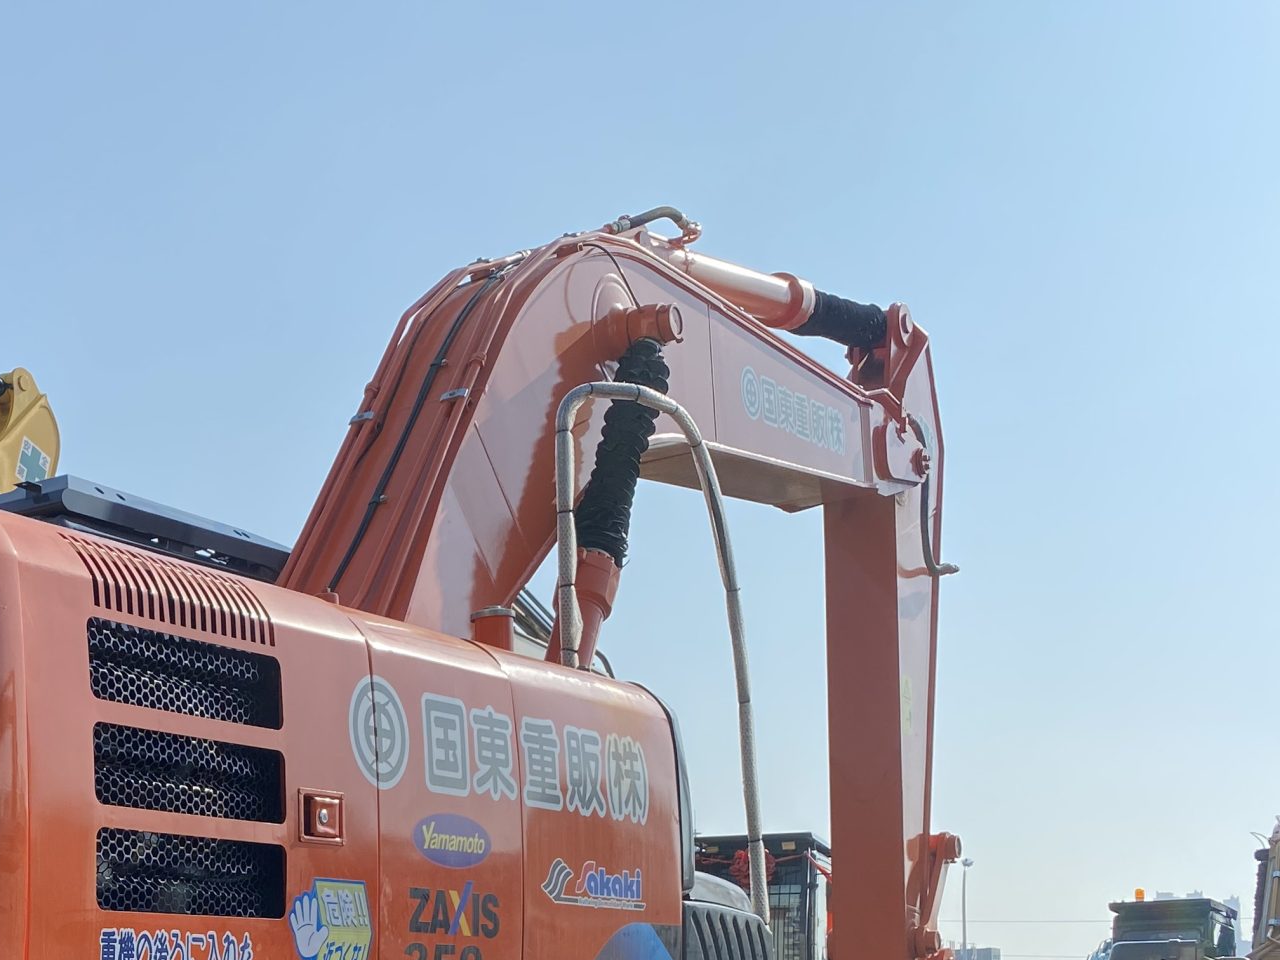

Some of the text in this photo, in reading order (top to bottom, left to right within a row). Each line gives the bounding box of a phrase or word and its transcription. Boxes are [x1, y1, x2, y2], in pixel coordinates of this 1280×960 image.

[422, 694, 648, 825] 国東重販(株)
[422, 821, 485, 854] Yamamoto
[576, 861, 642, 900] Sakaki
[409, 880, 500, 939] ZAXIS
